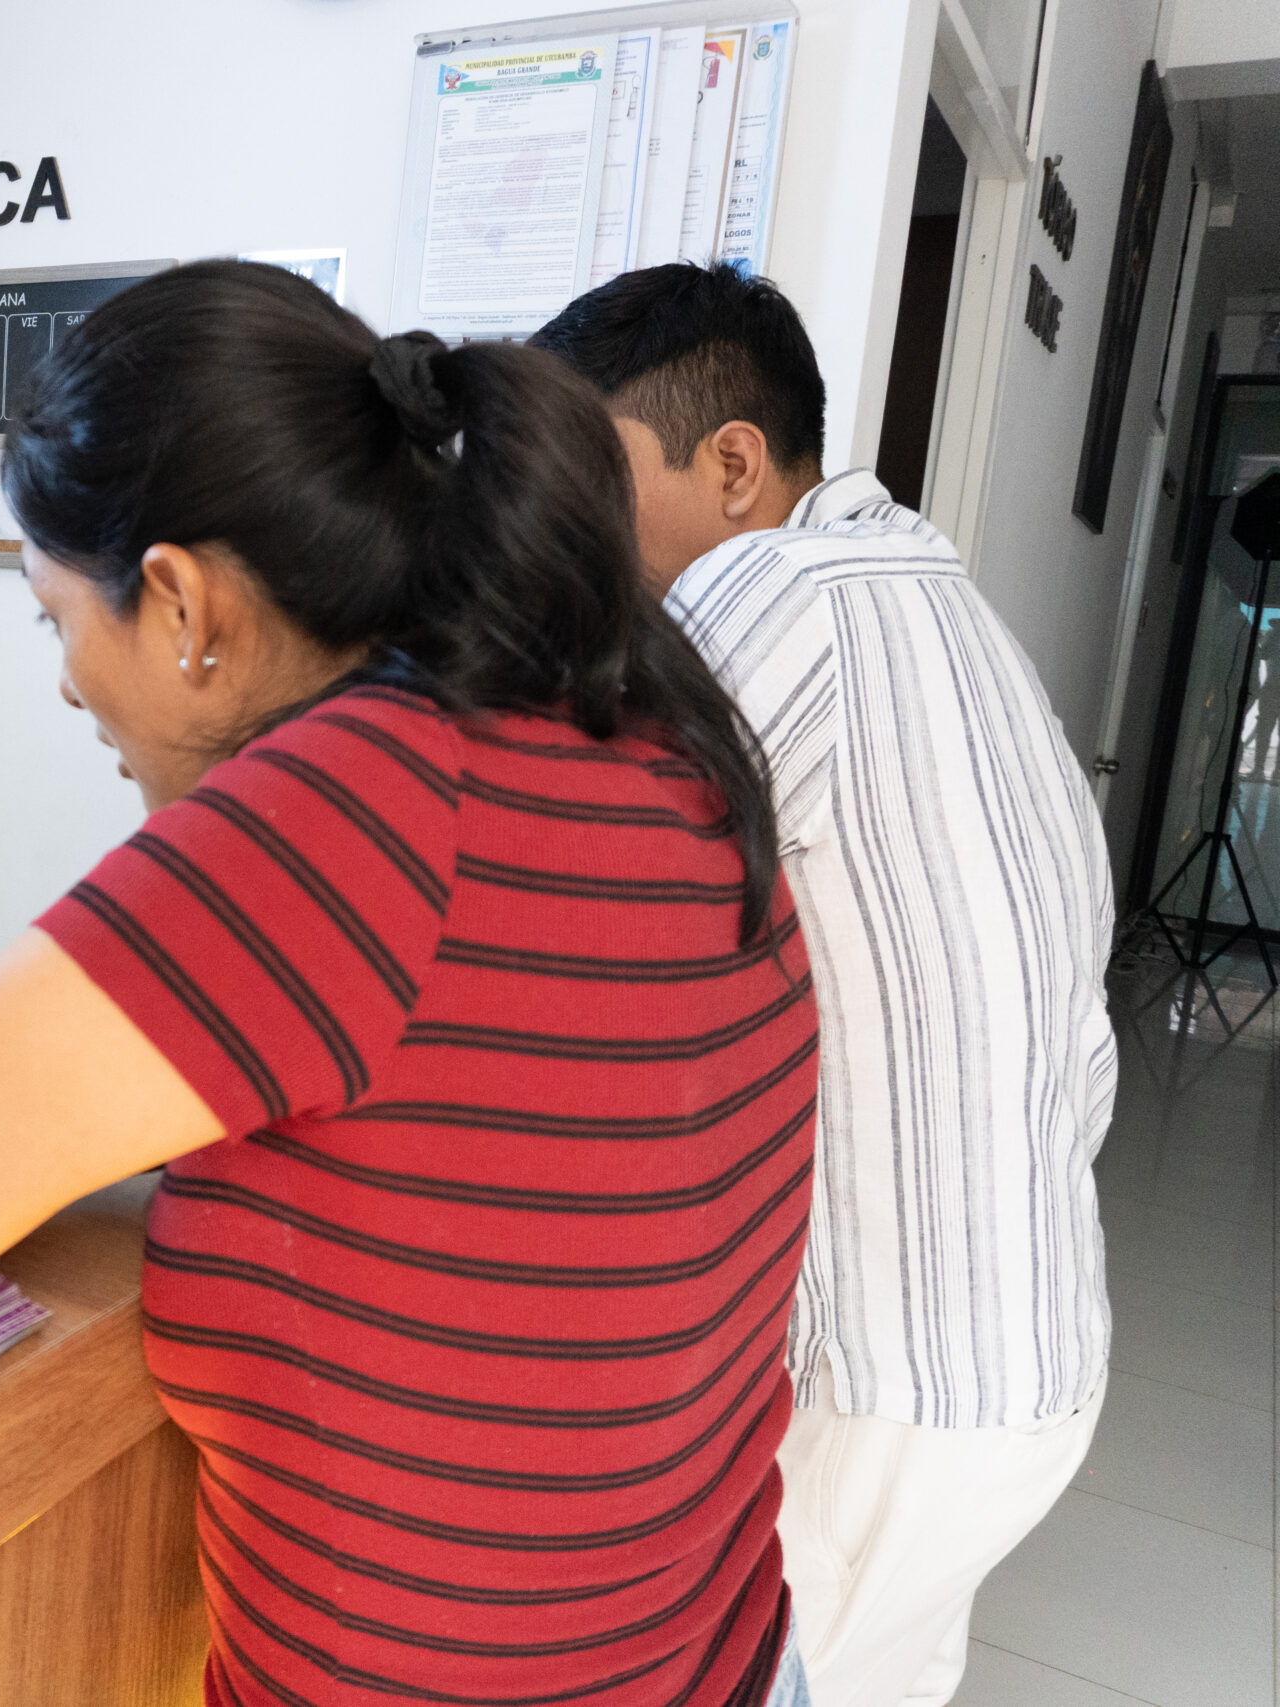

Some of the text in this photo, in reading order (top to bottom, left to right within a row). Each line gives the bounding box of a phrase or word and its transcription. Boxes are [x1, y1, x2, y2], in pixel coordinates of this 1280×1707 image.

[465, 59, 505, 70] MUNICIPALIDAD
[505, 56, 535, 66] PROVINCIAL
[536, 55, 543, 63] DE
[496, 65, 541, 76] BAGUA GRANDE
[21, 316, 38, 328] VIE
